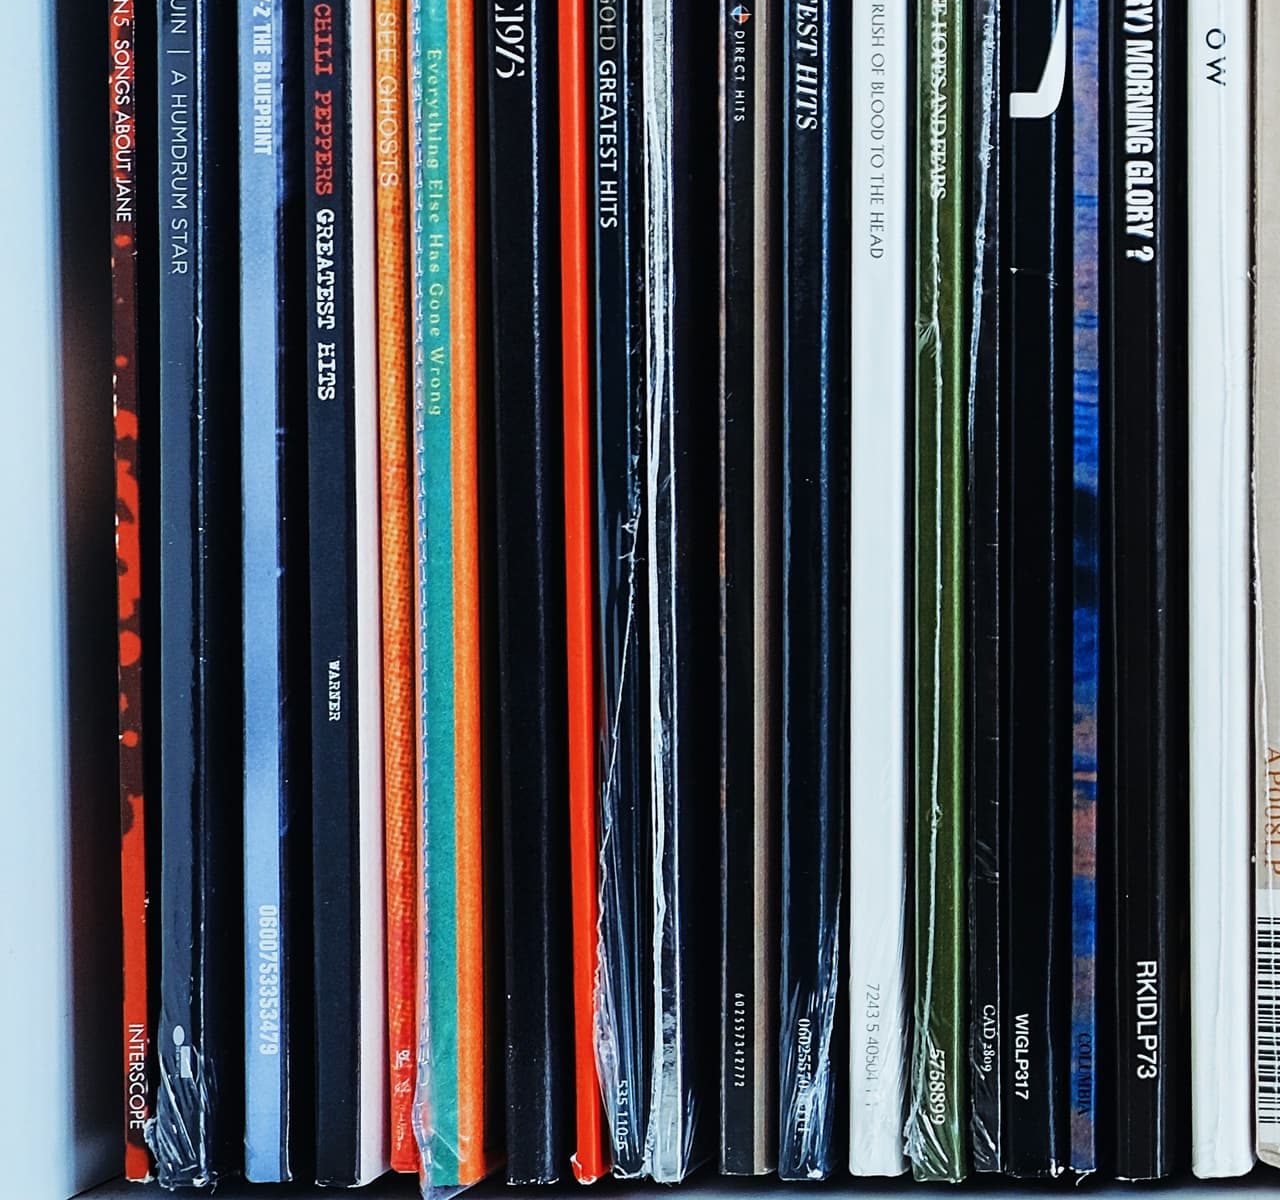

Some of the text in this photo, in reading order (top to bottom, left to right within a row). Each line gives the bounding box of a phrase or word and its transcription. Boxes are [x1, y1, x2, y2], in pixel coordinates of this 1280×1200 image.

[254, 23, 271, 54] THE
[314, 4, 332, 75] CHILI
[378, 12, 395, 61] SEE
[872, 4, 884, 46] RUSH
[171, 71, 186, 85] A
[872, 53, 884, 75] OF
[254, 62, 271, 154] BLUEPRINT
[796, 63, 817, 130] HITS
[871, 82, 884, 140] BLOOD
[171, 95, 187, 208] HUMDRUM
[315, 91, 332, 195] PEPPERS
[379, 76, 398, 187] GHOSTS
[871, 148, 884, 168] TO
[871, 177, 884, 204] THE
[169, 219, 187, 274] STAR
[870, 212, 884, 258] HEAD
[316, 209, 335, 329] GREATEST
[318, 343, 336, 400] HITS
[329, 660, 340, 721] WARNER
[983, 1005, 996, 1039] CAD
[1136, 961, 1157, 1079] RKIDLP73
[129, 1024, 145, 1130] INTERSCOPE
[1015, 1014, 1029, 1100] WIGLP317
